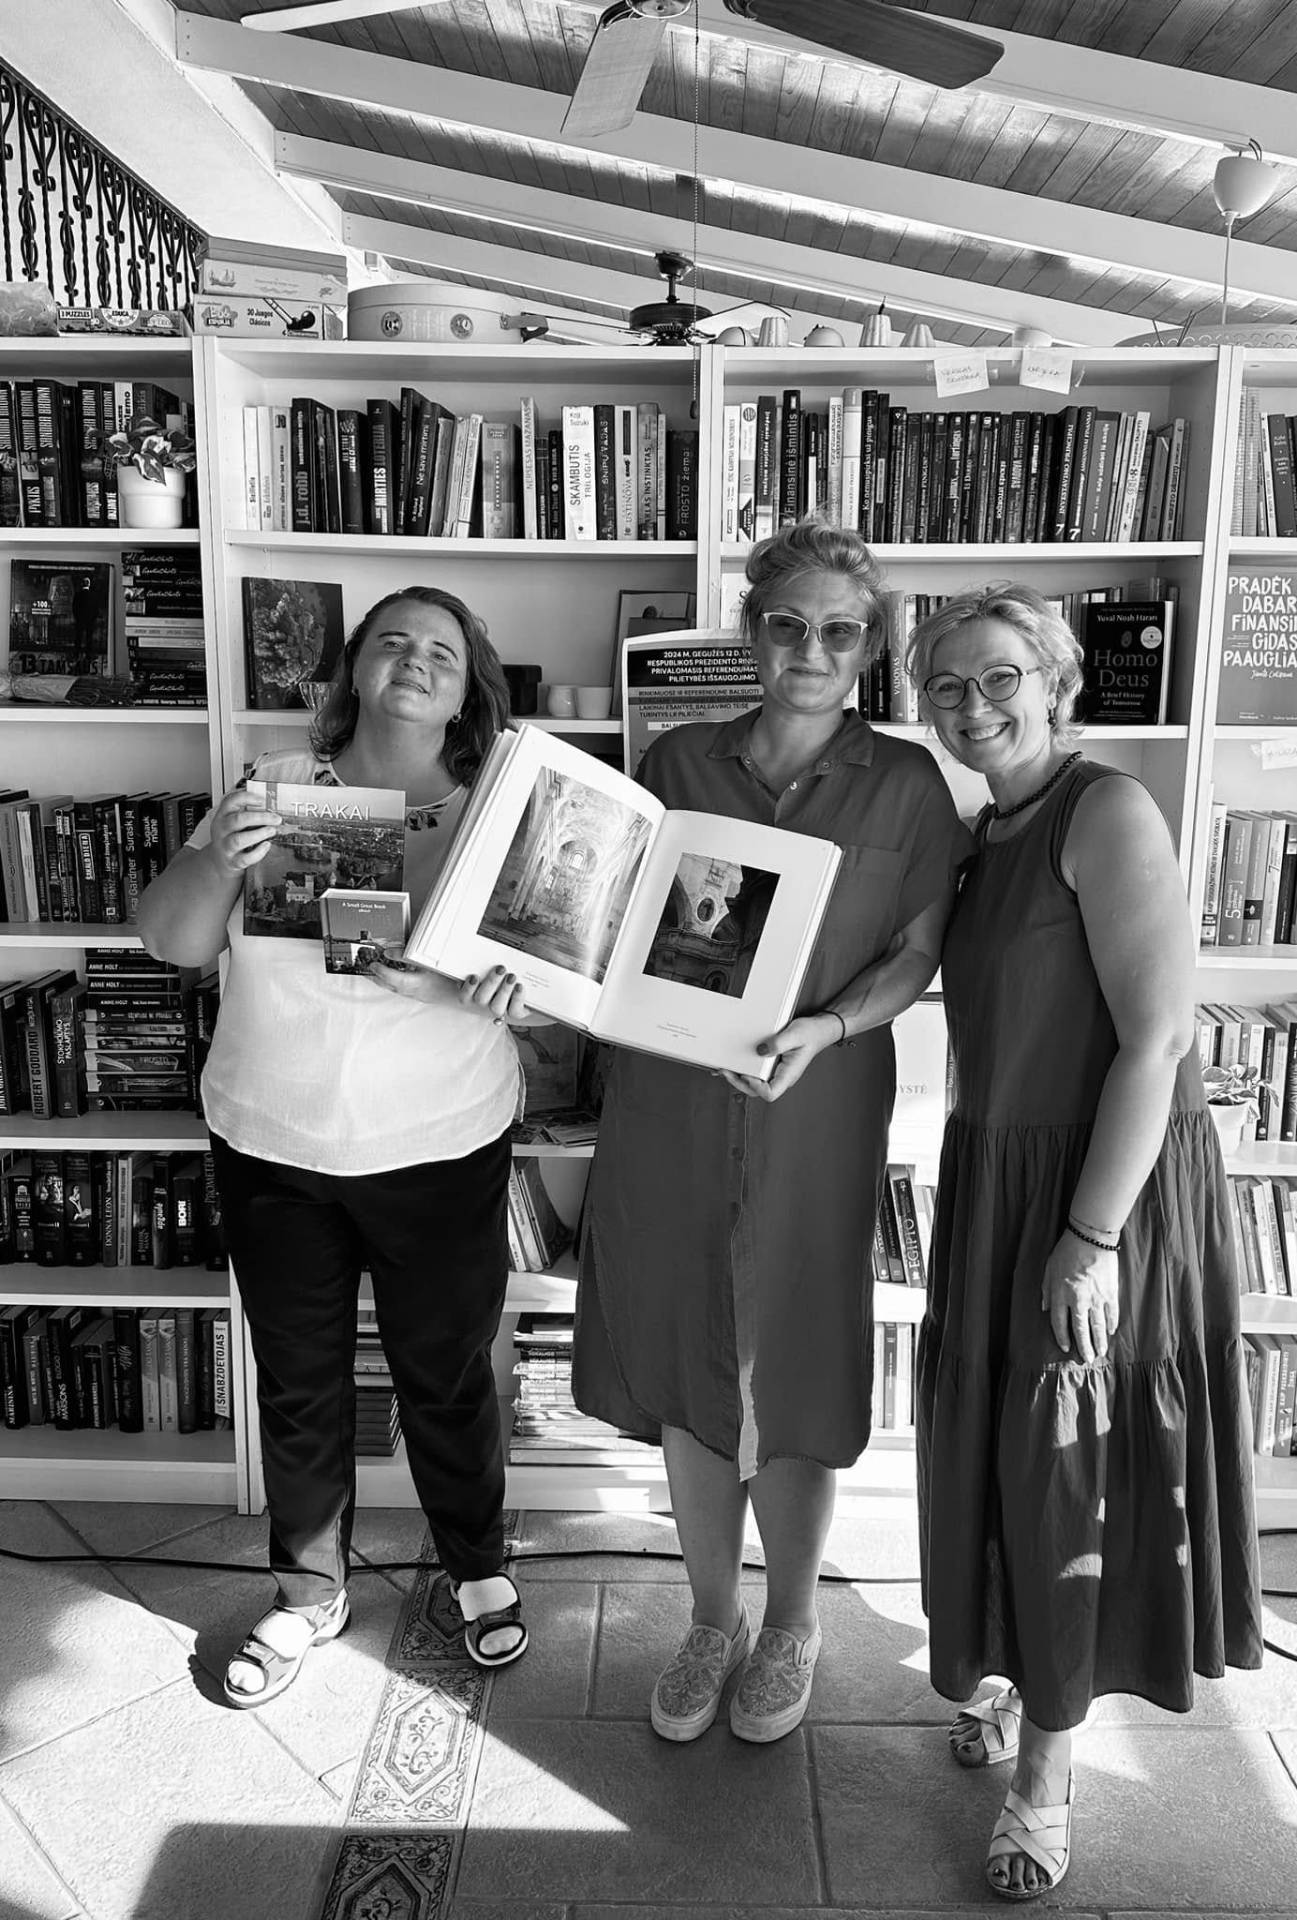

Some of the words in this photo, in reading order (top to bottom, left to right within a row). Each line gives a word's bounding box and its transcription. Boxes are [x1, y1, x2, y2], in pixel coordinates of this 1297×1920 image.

[36, 387, 52, 414] BROWN
[786, 412, 798, 457] išmintis
[568, 444, 581, 506] SKAMBUTIS
[584, 452, 592, 498] TRILOGIJA
[643, 447, 652, 495] INSTINKTAS
[1059, 463, 1071, 514] INVESTAVIMO
[1065, 423, 1075, 463] PRINCIPAI
[373, 467, 388, 507] MIRTIES
[784, 460, 796, 514] Finansinė
[1228, 575, 1292, 595] PRADĖK
[1116, 614, 1136, 622] Noah
[646, 659, 694, 667] RESPUBLIKOS
[695, 657, 738, 666] PREZIDENTO
[651, 666, 702, 675] PRIVALOMASIS
[703, 665, 758, 674] REFERENDUMAS
[1093, 649, 1159, 667] Homo
[668, 674, 706, 682] PILIETYBĖS
[707, 672, 756, 682] IŠSAUGOJIMO
[1099, 669, 1150, 688] Deus
[290, 801, 370, 821] TRAKAI
[125, 822, 135, 852] Surask
[150, 818, 159, 843] mane
[127, 858, 138, 896] Gardner
[27, 1031, 41, 1076] GODDARD
[55, 1018, 65, 1065] STOKHOLMO
[61, 1022, 72, 1060] PASLAPTYS
[34, 1077, 44, 1115] ROBERT
[104, 1196, 112, 1219] LEON
[105, 1219, 113, 1247] DONNA
[903, 1218, 921, 1268] EGIPTO
